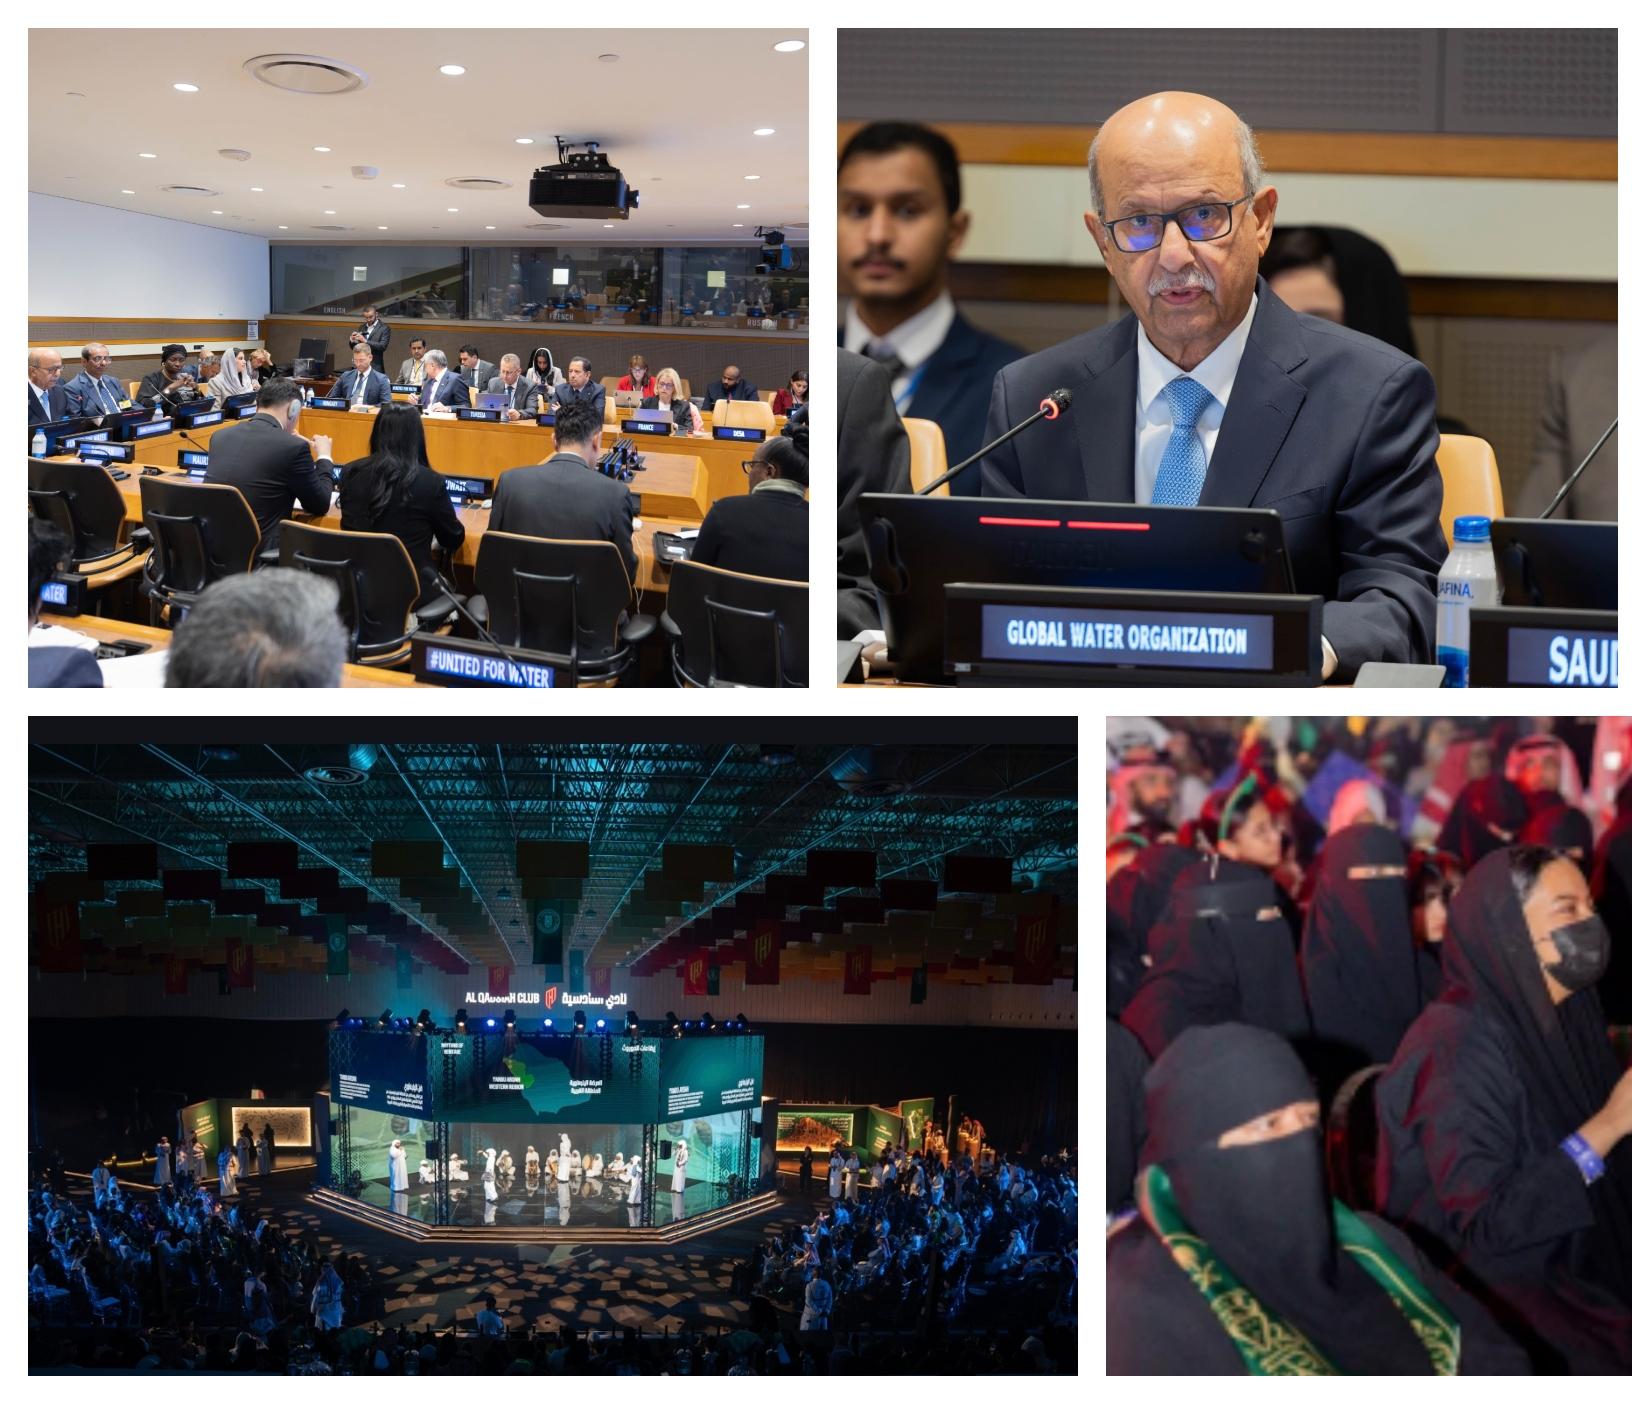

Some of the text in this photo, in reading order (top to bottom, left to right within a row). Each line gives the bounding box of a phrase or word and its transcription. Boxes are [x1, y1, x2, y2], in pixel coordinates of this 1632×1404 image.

[638, 423, 654, 431] FRANCE
[445, 479, 467, 492] UWAIT
[42, 584, 66, 602] ATER
[1007, 619, 1247, 655] GLOBAL WATER ORGANIZATION
[430, 650, 480, 676] #UNITED
[483, 660, 506, 681] FOR
[517, 992, 540, 1003] CLUB
